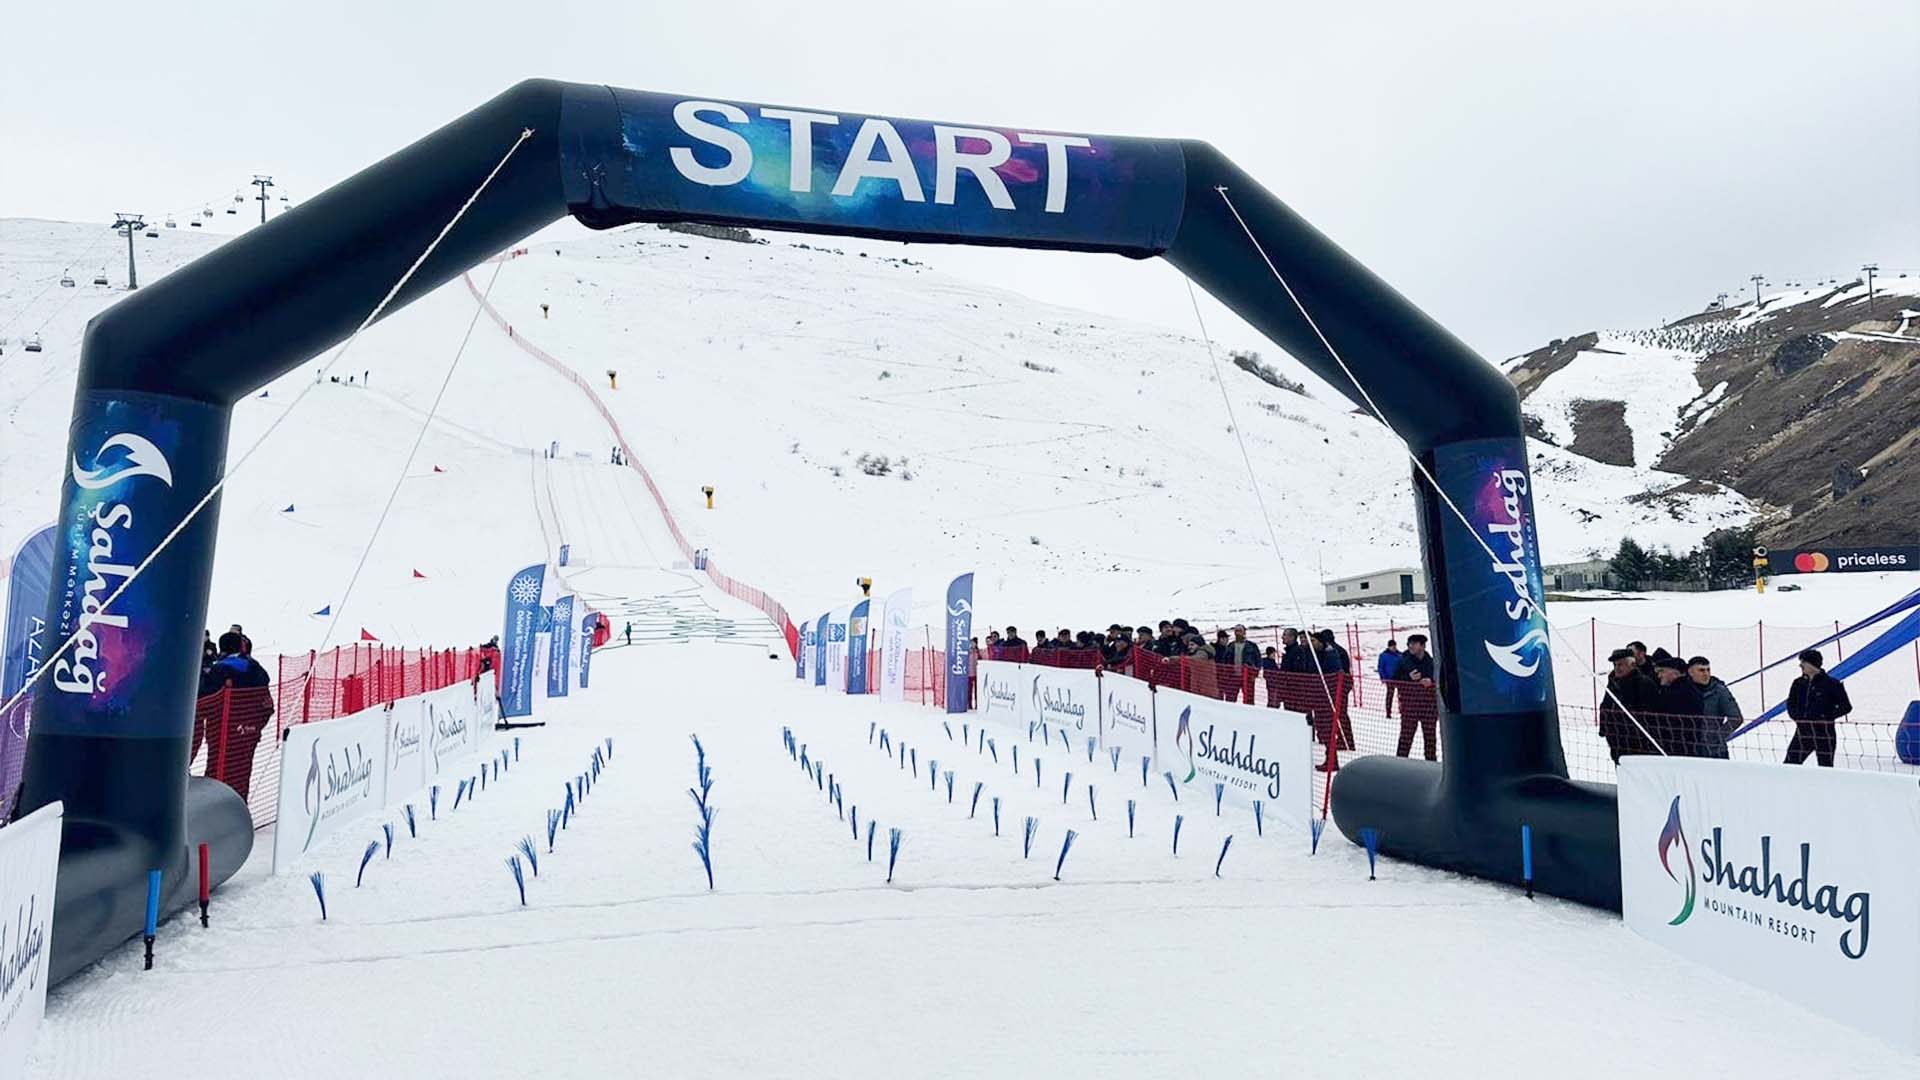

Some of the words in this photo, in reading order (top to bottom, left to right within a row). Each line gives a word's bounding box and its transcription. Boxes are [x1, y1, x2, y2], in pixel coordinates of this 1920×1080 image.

[669, 100, 1091, 213] START
[1488, 469, 1533, 620] Şahdağ
[1837, 552, 1907, 568] priceless
[54, 502, 137, 694] Şahdağ
[1043, 686, 1085, 730] Shahdag
[1116, 700, 1146, 734] Shahdag
[1197, 724, 1280, 799] Shahdag
[1231, 776, 1258, 791] RESORT
[1701, 827, 1870, 960] Shahdag
[1703, 895, 1763, 927] MOUNTAIN
[1768, 916, 1817, 945] RESORT
[0, 894, 44, 1000] hahdag
